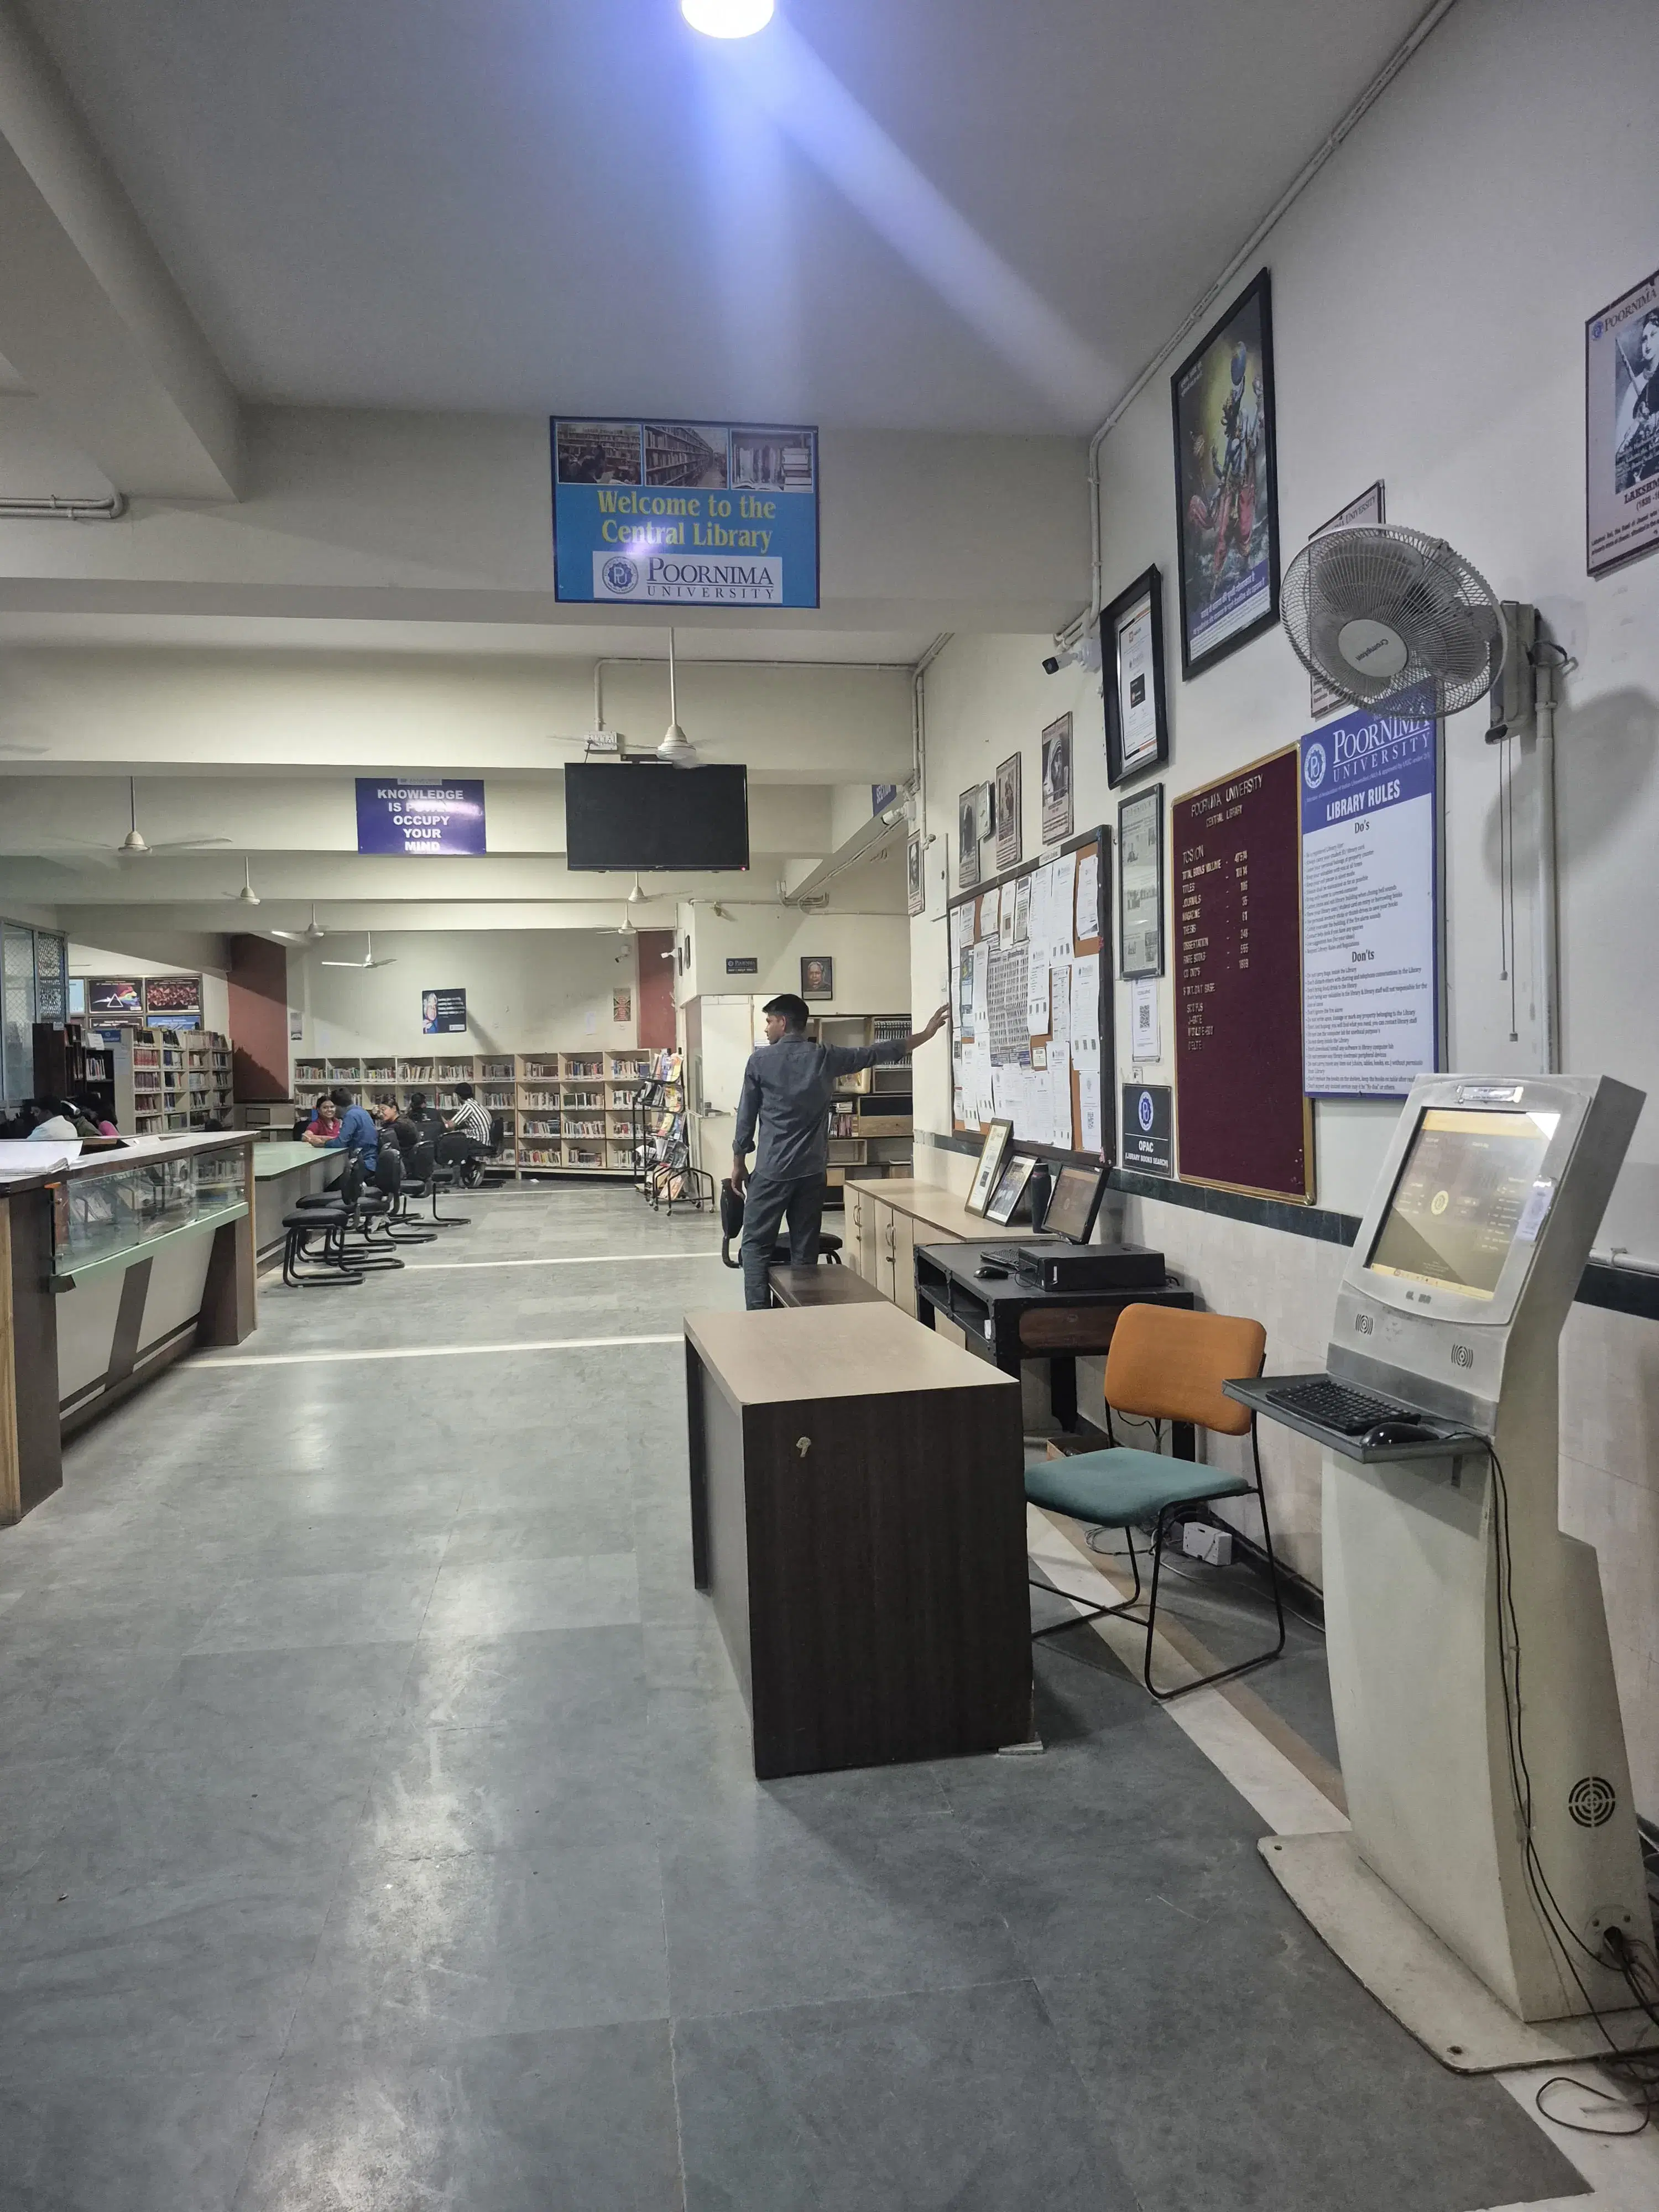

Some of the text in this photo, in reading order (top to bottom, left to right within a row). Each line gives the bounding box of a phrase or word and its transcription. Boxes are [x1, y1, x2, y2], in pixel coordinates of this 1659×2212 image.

[597, 490, 776, 519] Welcome to the
[601, 520, 772, 554] Central Library
[646, 557, 774, 585] POORNIMA
[647, 585, 774, 599] UNIVERSITY
[1333, 731, 1431, 783] UNIVERSITY
[377, 789, 465, 800] KNOWLEDGE
[1191, 773, 1262, 817] POORNIMA UNIVERSITY
[1327, 790, 1365, 821] LIBRARY
[1368, 778, 1401, 808] RULES
[388, 802, 403, 812] IS
[393, 815, 451, 826] OCCUPY
[1354, 819, 1370, 834] Do's
[403, 828, 442, 839] YOUR
[404, 841, 441, 852] MIND
[1352, 950, 1375, 963] Don'ts
[1139, 1140, 1154, 1153] OPAC
